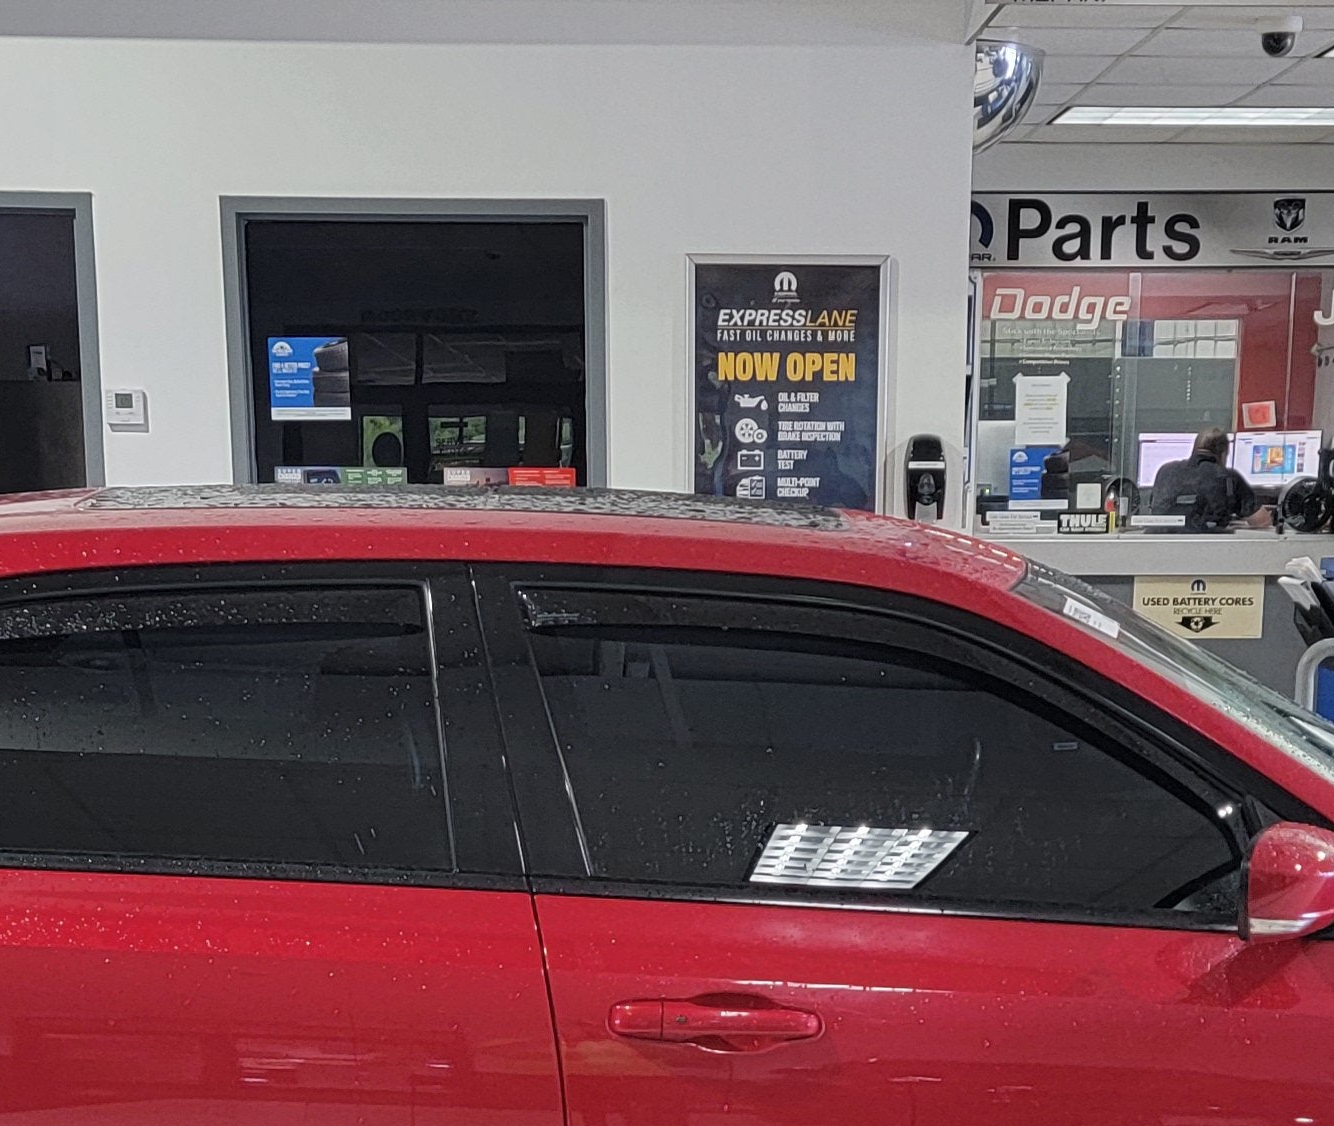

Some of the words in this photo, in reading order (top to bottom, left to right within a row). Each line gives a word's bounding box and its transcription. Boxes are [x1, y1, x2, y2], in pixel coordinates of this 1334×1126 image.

[1006, 198, 1201, 262] Parts
[1268, 236, 1308, 244] RAM
[990, 286, 1132, 330] Dodge
[717, 330, 742, 342] FAST
[745, 330, 762, 342] OIL
[767, 330, 813, 342] CHANGES
[817, 330, 823, 342] &
[828, 330, 856, 342] MORE
[717, 352, 780, 382] NOW
[786, 352, 856, 382] OPEN
[778, 392, 789, 402] OIL
[777, 449, 808, 460] BATTERY
[777, 460, 794, 470] TEST
[1060, 514, 1107, 527] THULE
[1142, 597, 1169, 606] USED
[1172, 597, 1217, 606] BATTERY
[1219, 597, 1254, 606] CORES
[1173, 607, 1202, 615] RECYCLE
[1204, 607, 1223, 615] HERE
